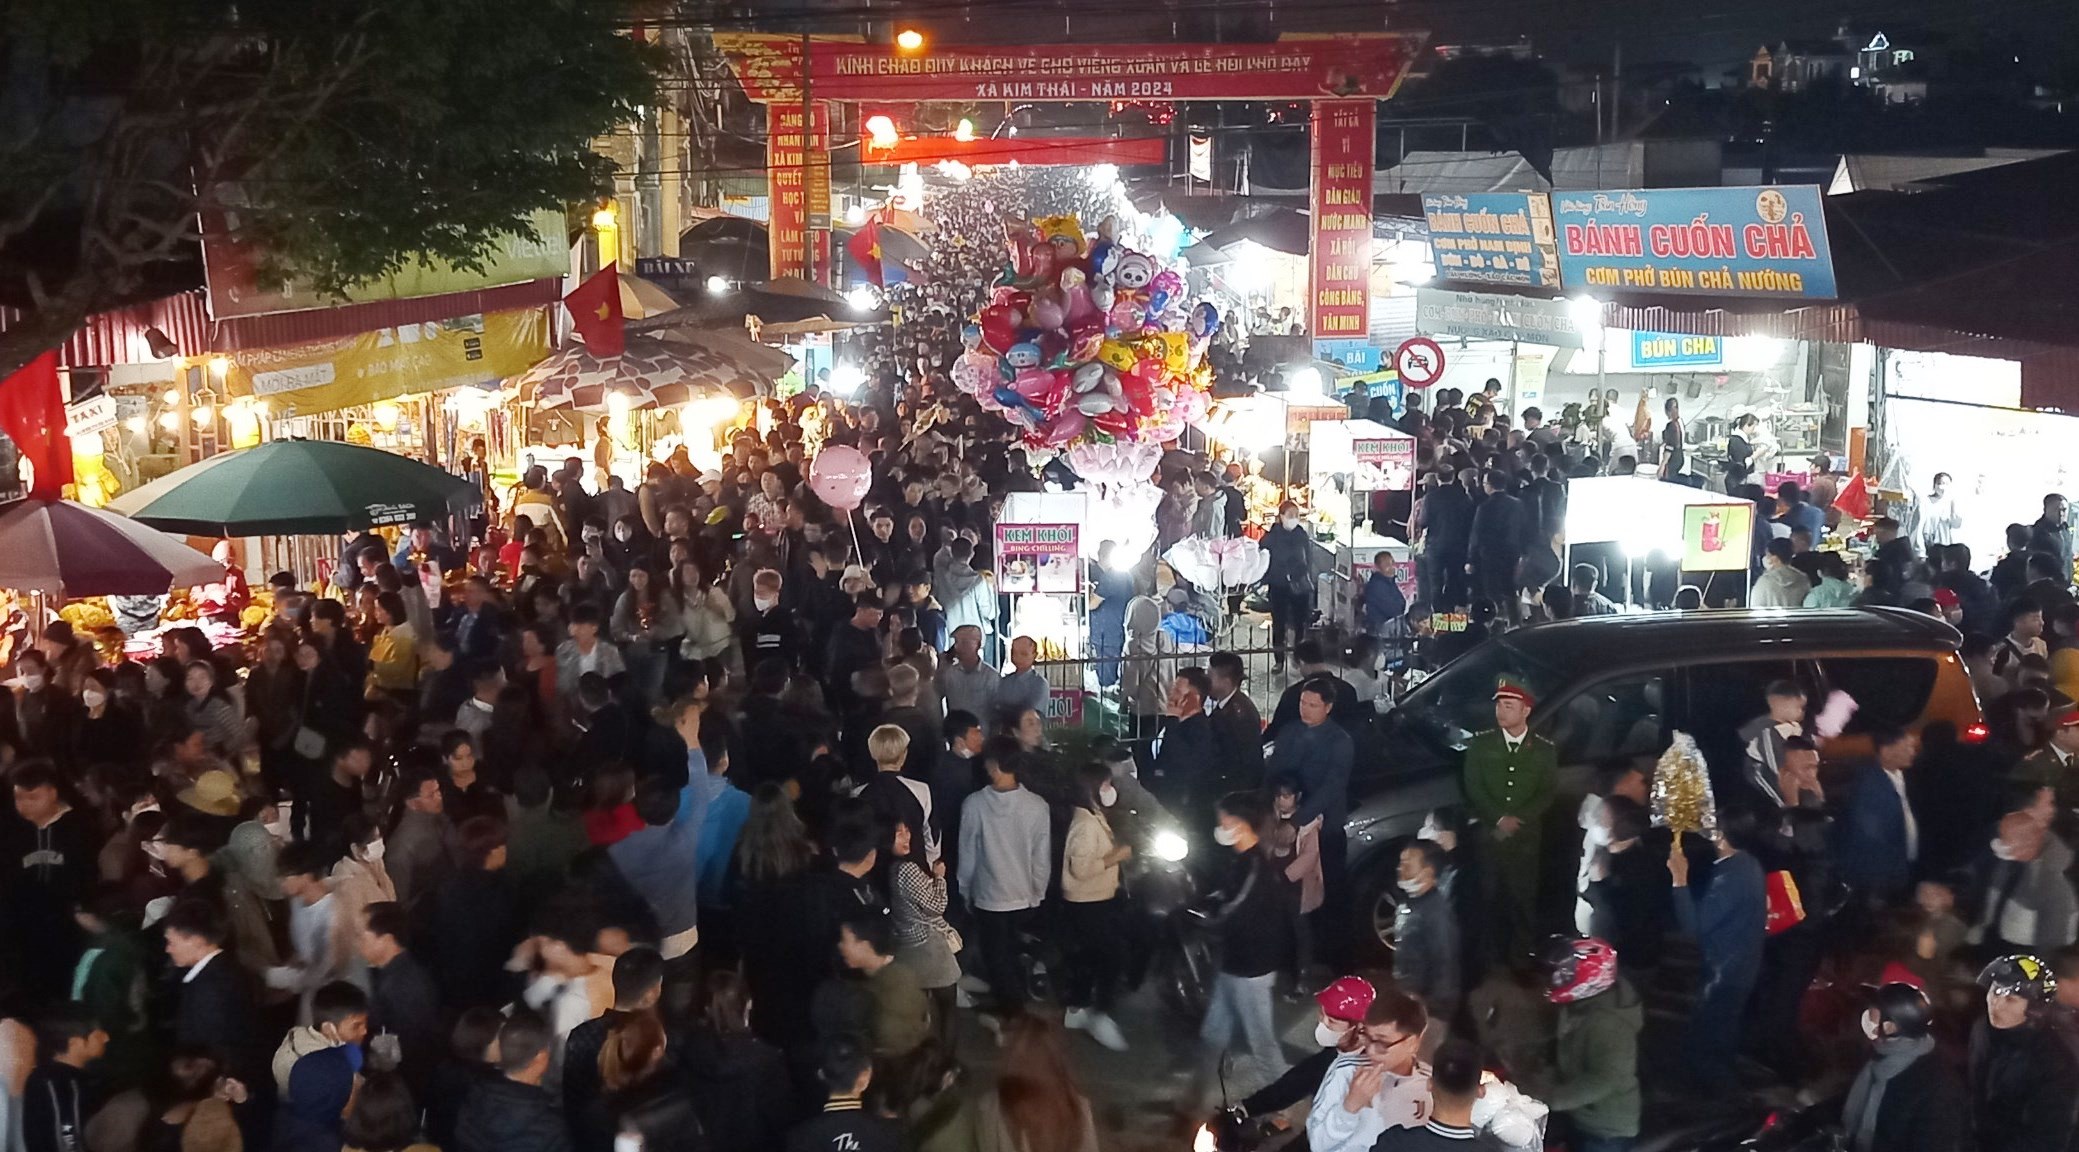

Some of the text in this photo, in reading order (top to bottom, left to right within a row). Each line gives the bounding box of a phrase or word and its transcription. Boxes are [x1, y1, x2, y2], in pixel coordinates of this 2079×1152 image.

[976, 81, 998, 97] XÃ
[1003, 83, 1032, 97] KIM
[1037, 80, 1076, 97] THÁI
[1091, 79, 1126, 97] NĂM
[1131, 81, 1173, 96] 2024
[782, 191, 799, 207] HỌC
[1325, 186, 1341, 205] DÂN
[1321, 212, 1343, 230] NƯỚC
[781, 227, 799, 243] LÀM
[1565, 212, 1817, 260] BÁNH CUỐN CHẢ
[1330, 238, 1341, 256] XÃ
[1326, 262, 1341, 281] DÂN
[1586, 264, 1803, 292] CƠM PHỞ BÚN CHẢ NƯỚNG
[1319, 288, 1340, 306] CÔNG
[1323, 312, 1360, 331] VĂN MINH
[1640, 337, 1678, 359] BÚN
[70, 404, 103, 424] TAXI
[1357, 442, 1379, 454] KEM
[1002, 525, 1074, 543] KEM KHÓI
[1031, 544, 1067, 552] CHILLING
[1045, 693, 1073, 718] HÓI
[832, 1132, 861, 1152] The
